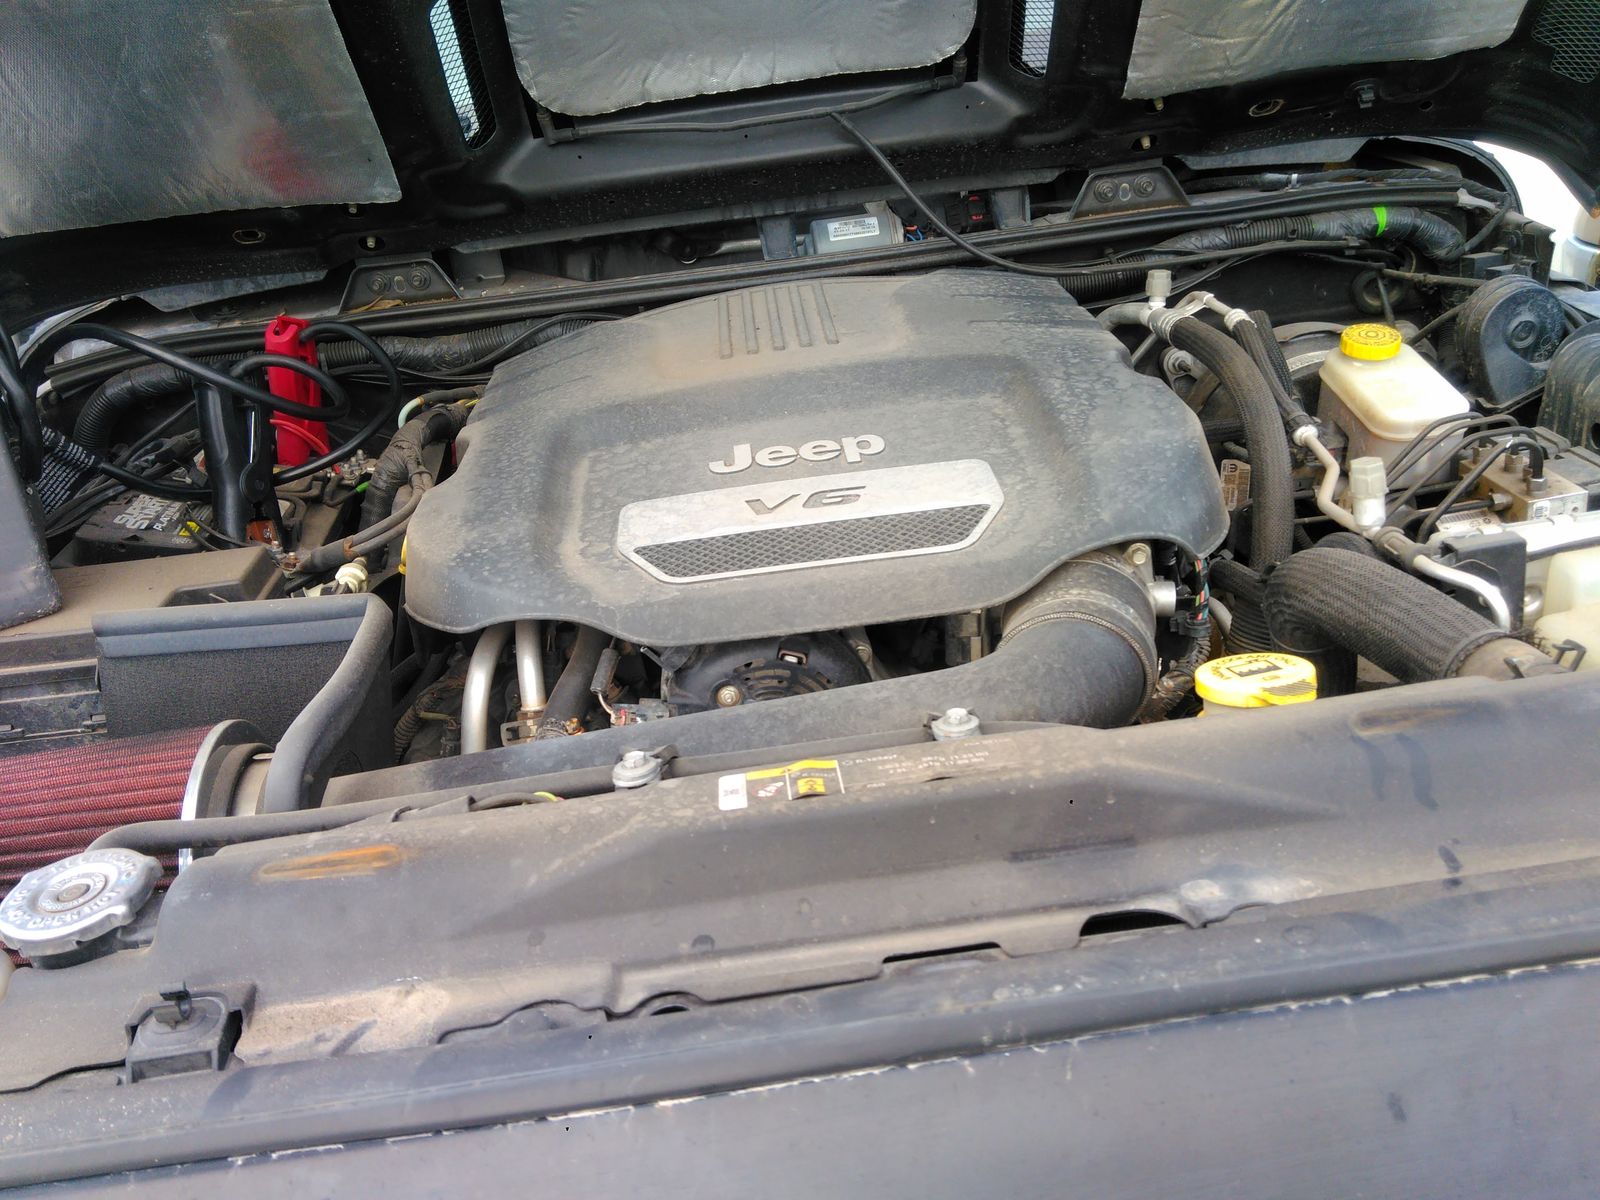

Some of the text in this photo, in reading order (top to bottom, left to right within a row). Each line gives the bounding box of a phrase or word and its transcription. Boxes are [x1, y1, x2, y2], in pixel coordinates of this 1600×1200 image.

[708, 434, 886, 474] Jeep
[113, 493, 157, 525] SUPER
[125, 499, 170, 530] START
[744, 485, 867, 516] V6
